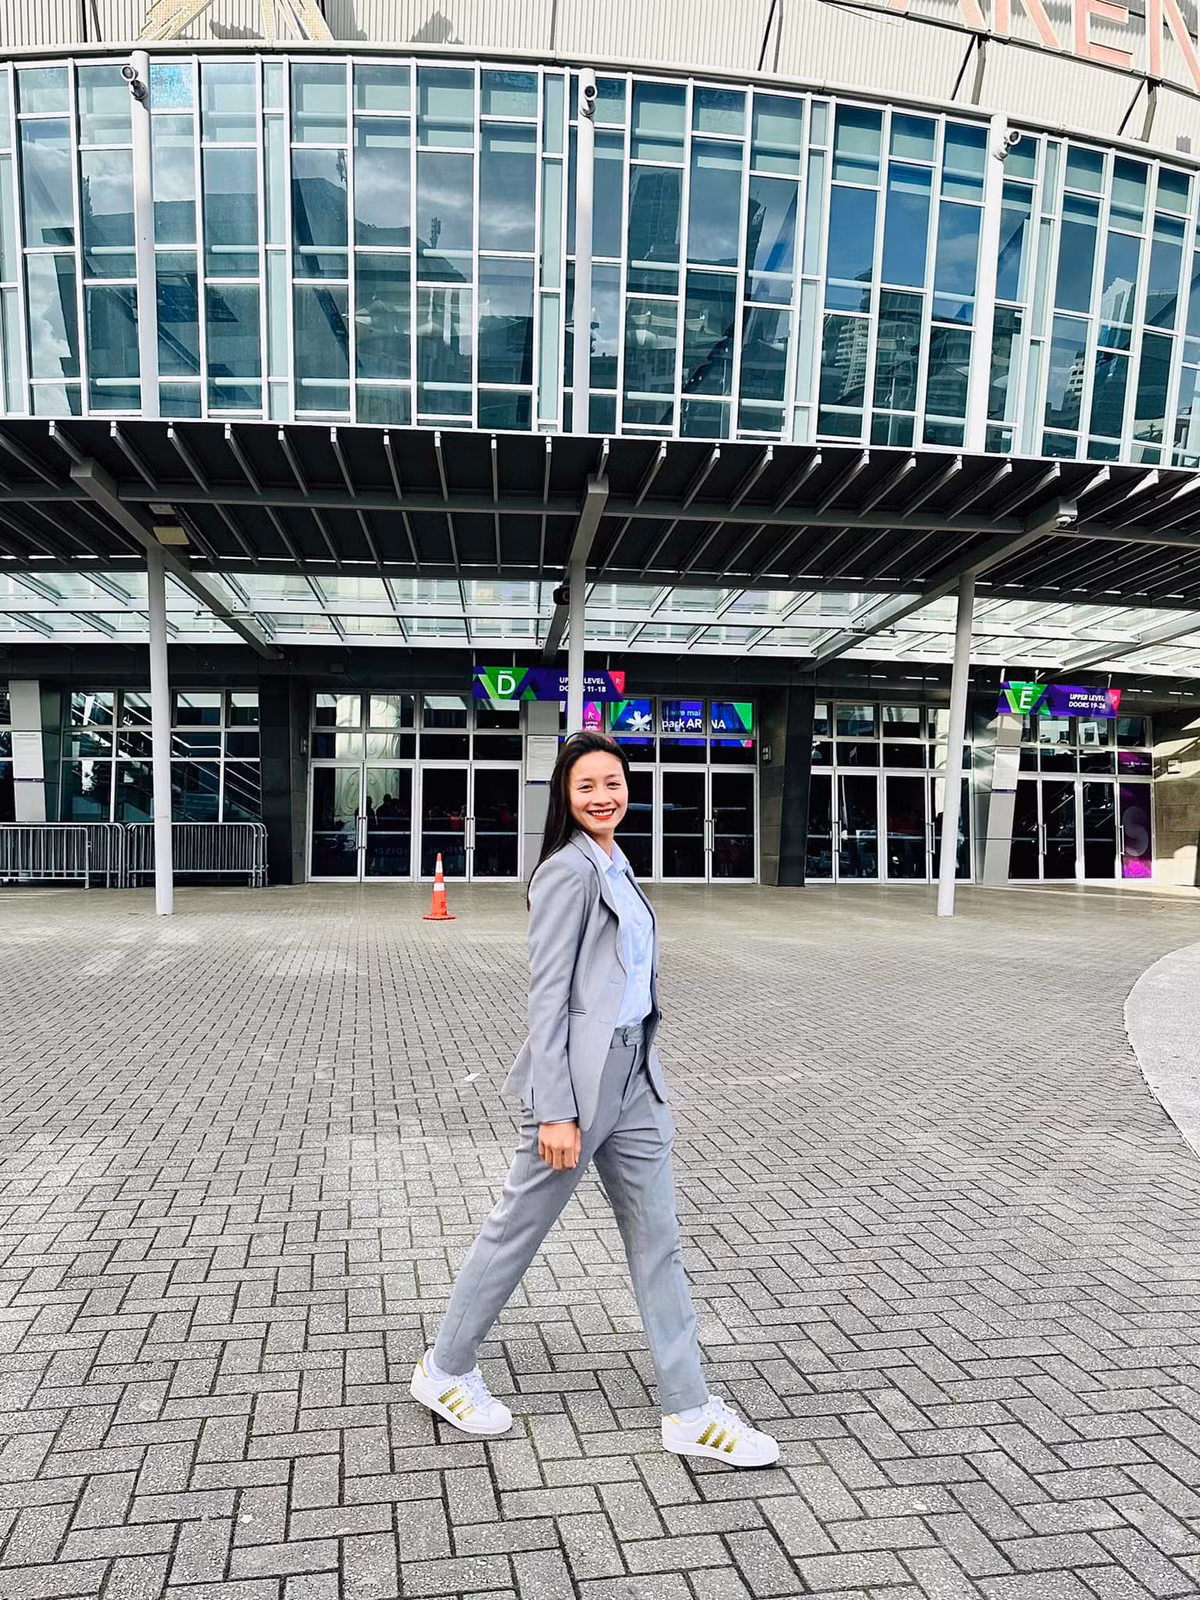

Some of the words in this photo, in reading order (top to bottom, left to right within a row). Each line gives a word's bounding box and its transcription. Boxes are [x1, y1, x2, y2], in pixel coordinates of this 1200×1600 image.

[498, 674, 516, 695] D
[584, 677, 605, 685] LEVEL
[587, 685, 607, 693] 11-18
[1019, 690, 1034, 708] E
[1070, 693, 1089, 701] UPPER
[1089, 694, 1105, 702] LEVEL
[686, 717, 727, 731] ARNA
